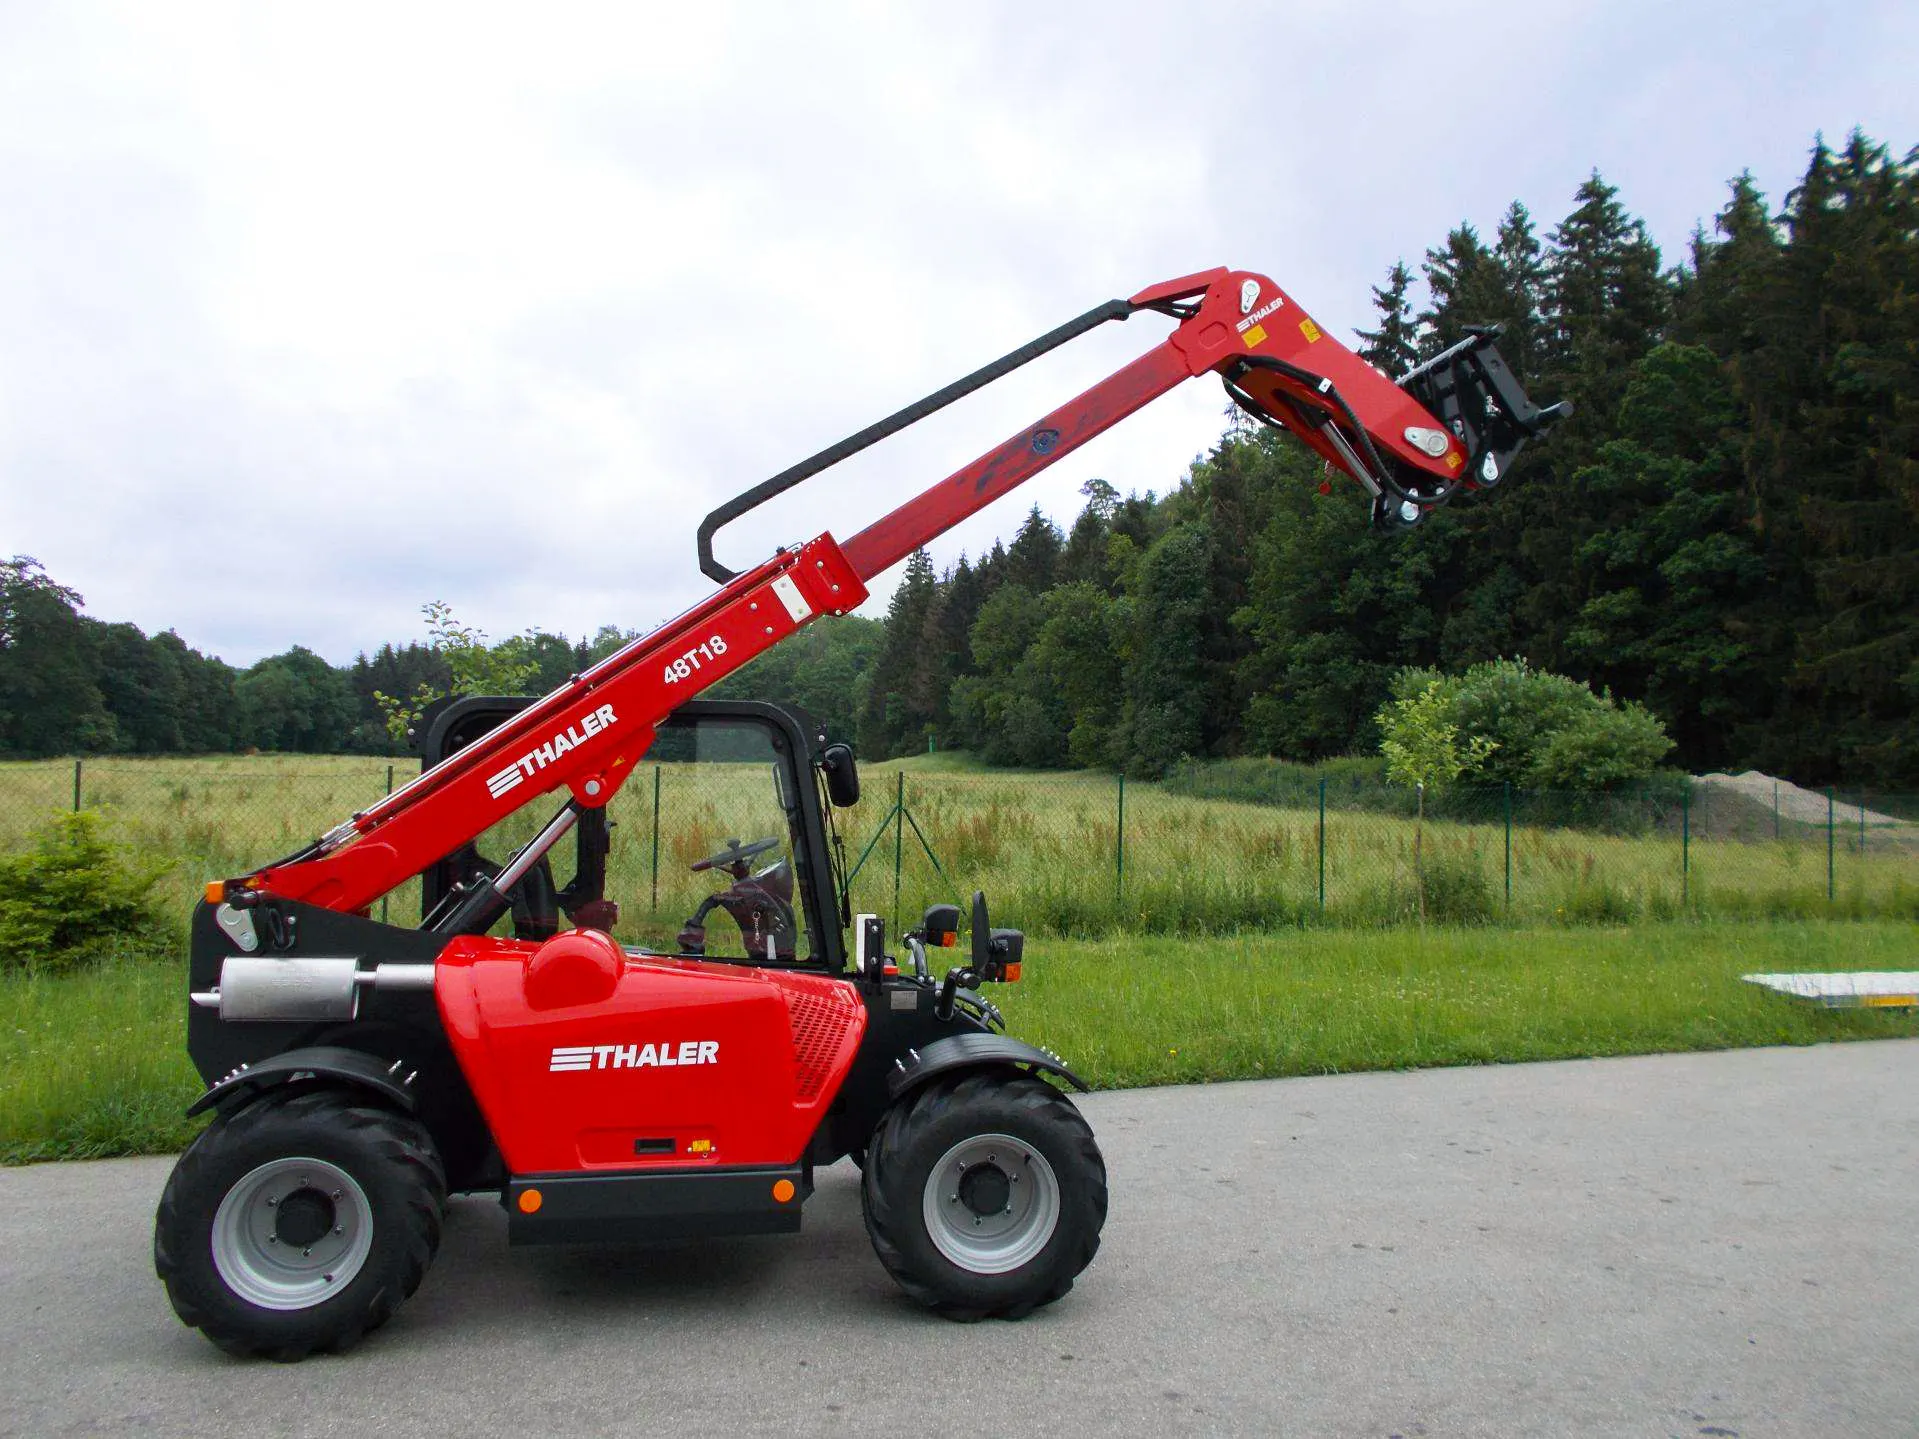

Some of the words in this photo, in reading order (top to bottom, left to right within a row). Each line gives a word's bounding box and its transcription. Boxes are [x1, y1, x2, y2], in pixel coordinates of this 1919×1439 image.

[1248, 297, 1284, 325] THALER
[664, 635, 728, 684] 48T18
[516, 703, 619, 777] THALER
[592, 1040, 720, 1071] THALER
